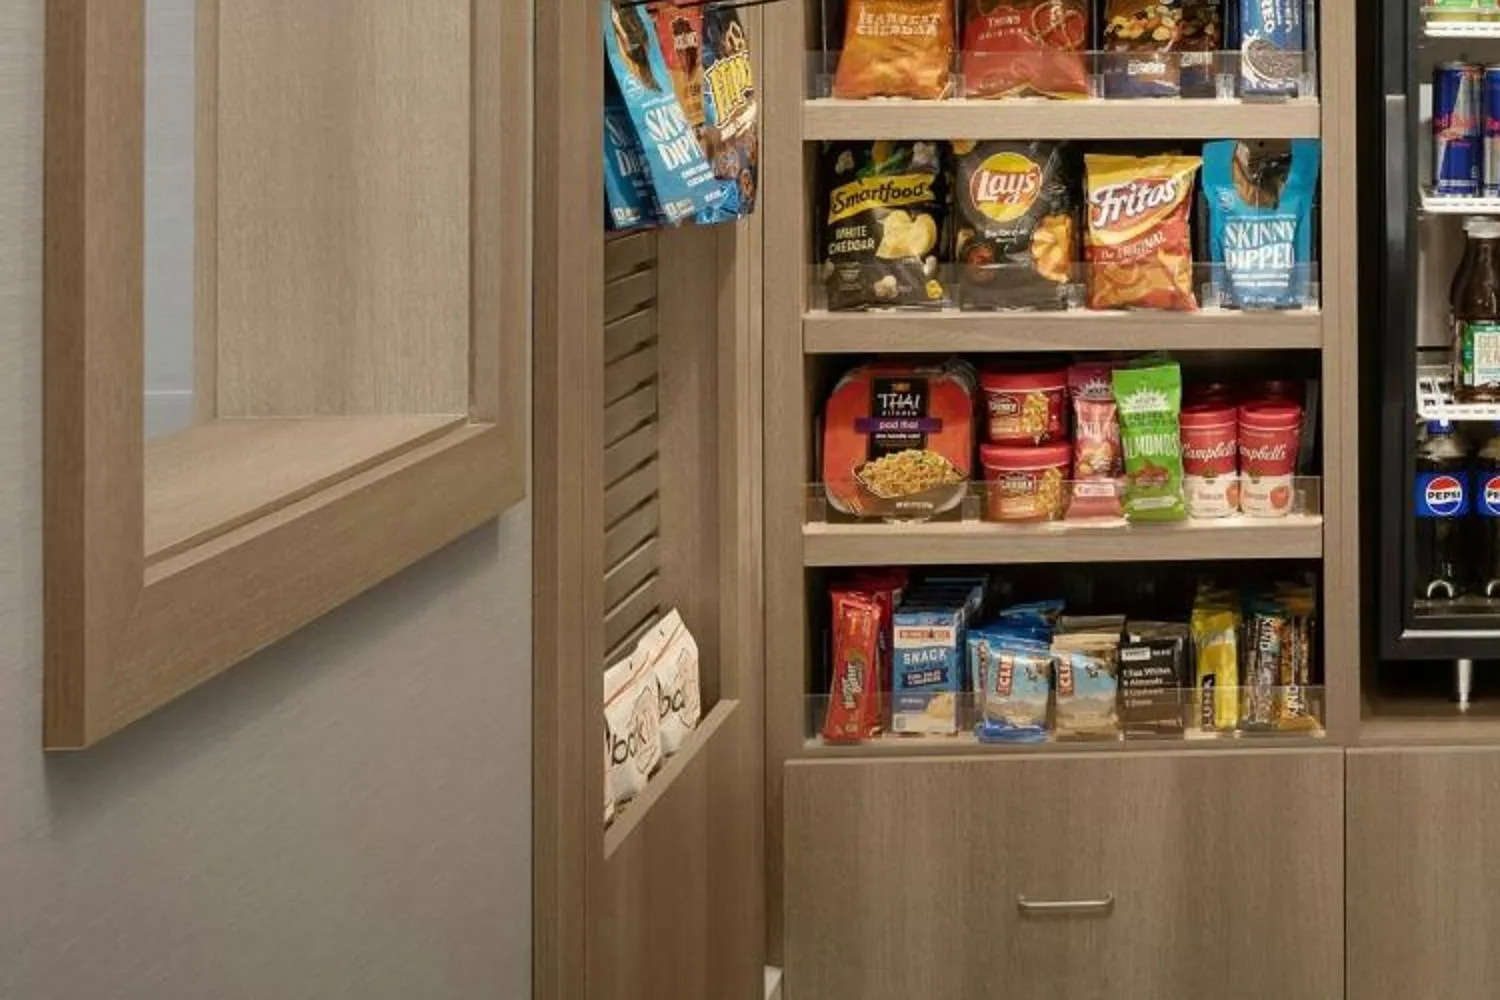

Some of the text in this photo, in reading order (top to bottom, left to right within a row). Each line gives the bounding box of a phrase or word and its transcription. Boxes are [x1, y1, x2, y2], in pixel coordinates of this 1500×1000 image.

[830, 177, 927, 215] Smartfood
[1090, 176, 1178, 229] Fritos
[835, 225, 868, 241] WHITE
[1225, 220, 1297, 249] SKINNY
[828, 237, 875, 255] CHEDDAR
[876, 393, 921, 409] THAI
[1428, 489, 1461, 500] PEPSI
[1259, 617, 1274, 651] KIND
[904, 647, 949, 665] SNACK
